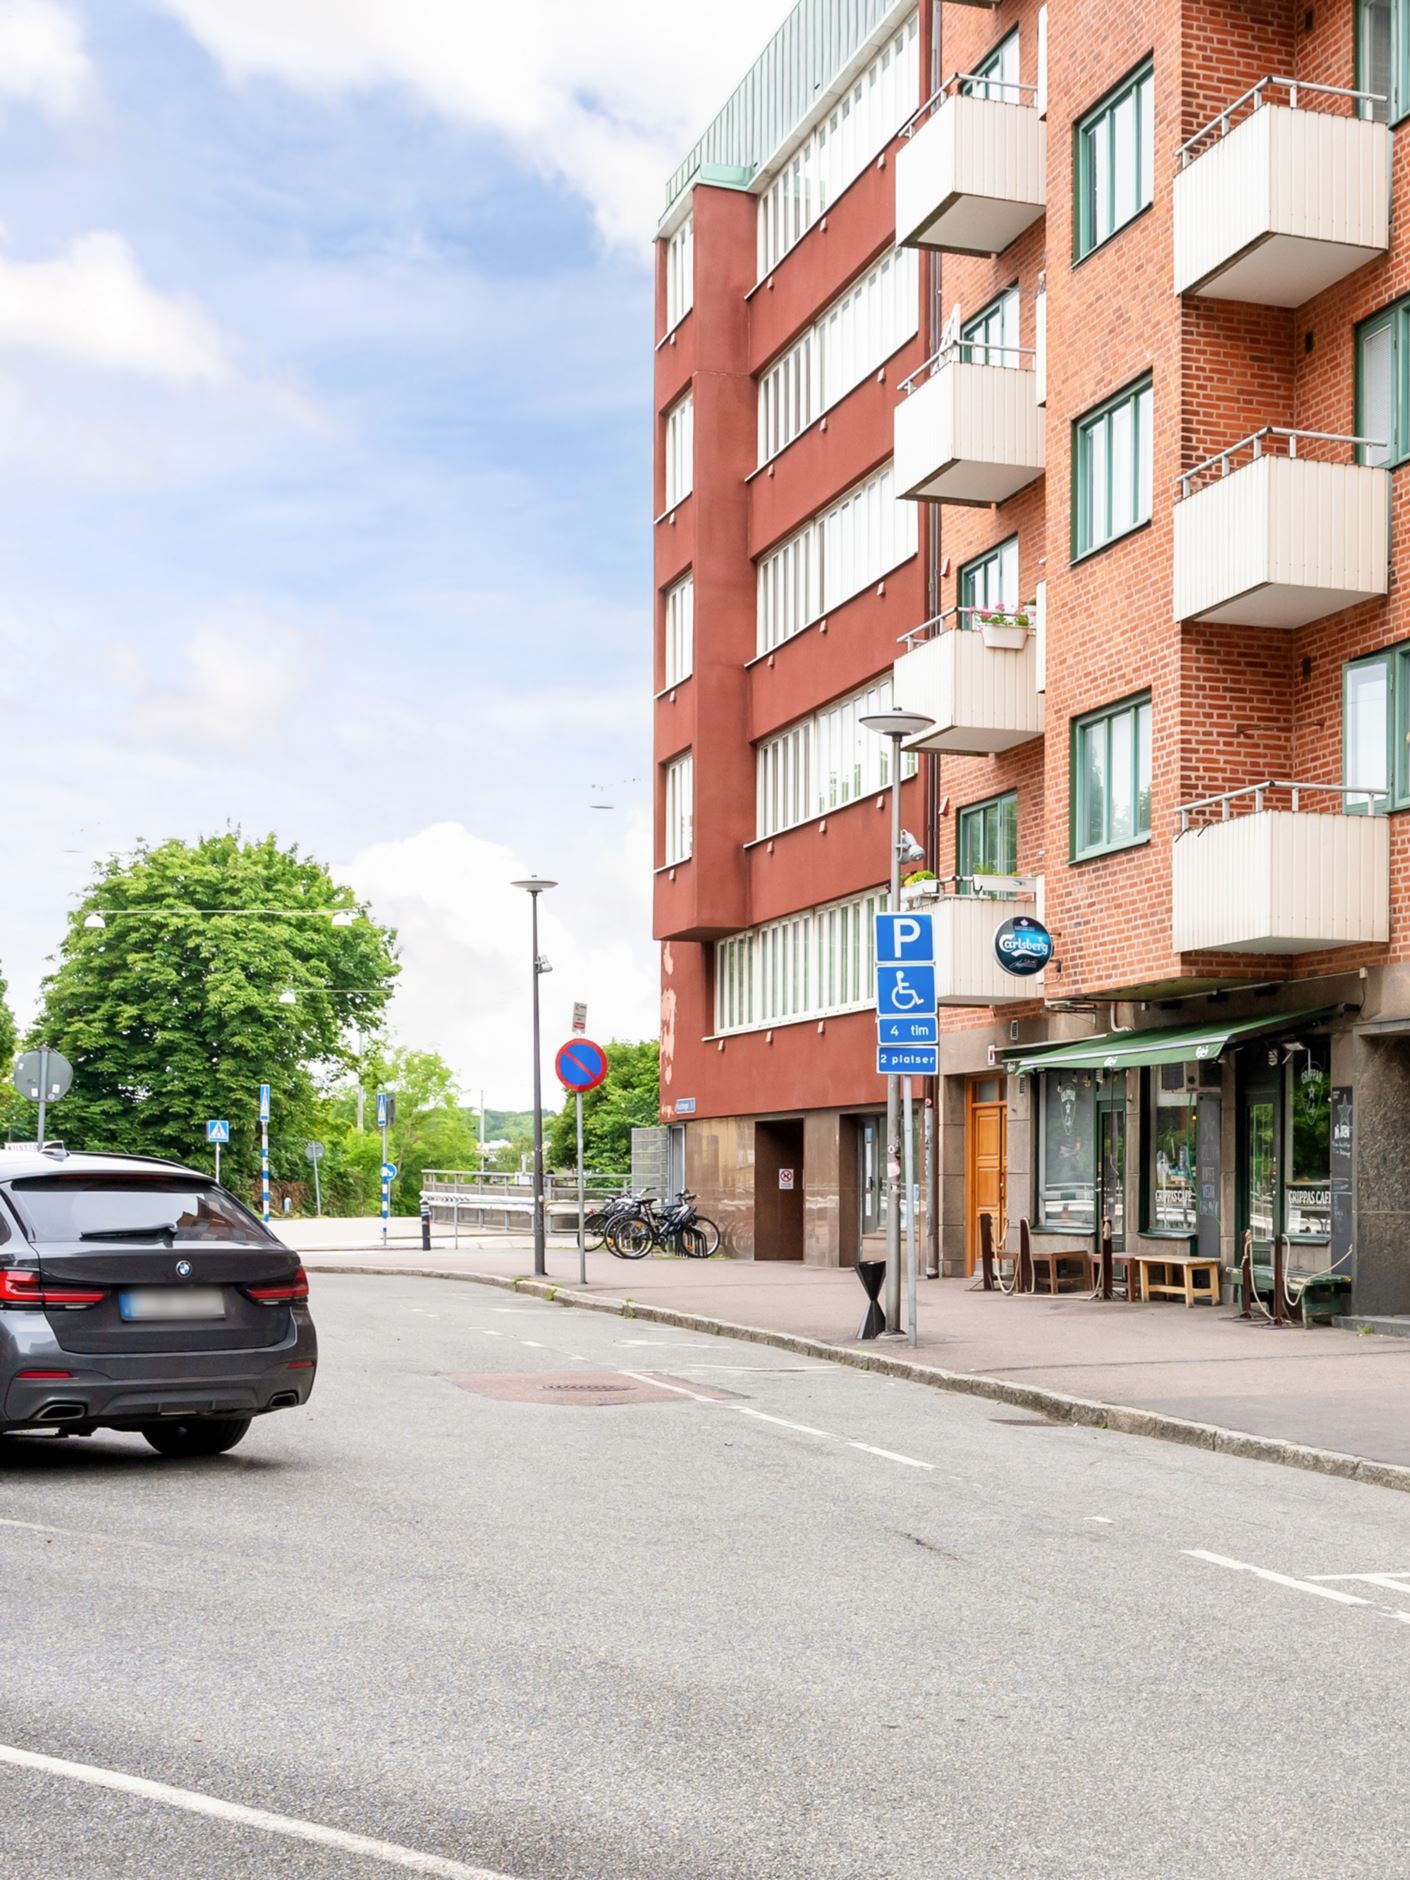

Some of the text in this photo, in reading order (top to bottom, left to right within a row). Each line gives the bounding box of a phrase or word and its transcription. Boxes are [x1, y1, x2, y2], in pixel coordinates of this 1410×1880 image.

[893, 918, 921, 958] P
[998, 933, 1048, 956] Carlsberg
[890, 1024, 929, 1037] 4 tim
[880, 1053, 935, 1065] 2 platser
